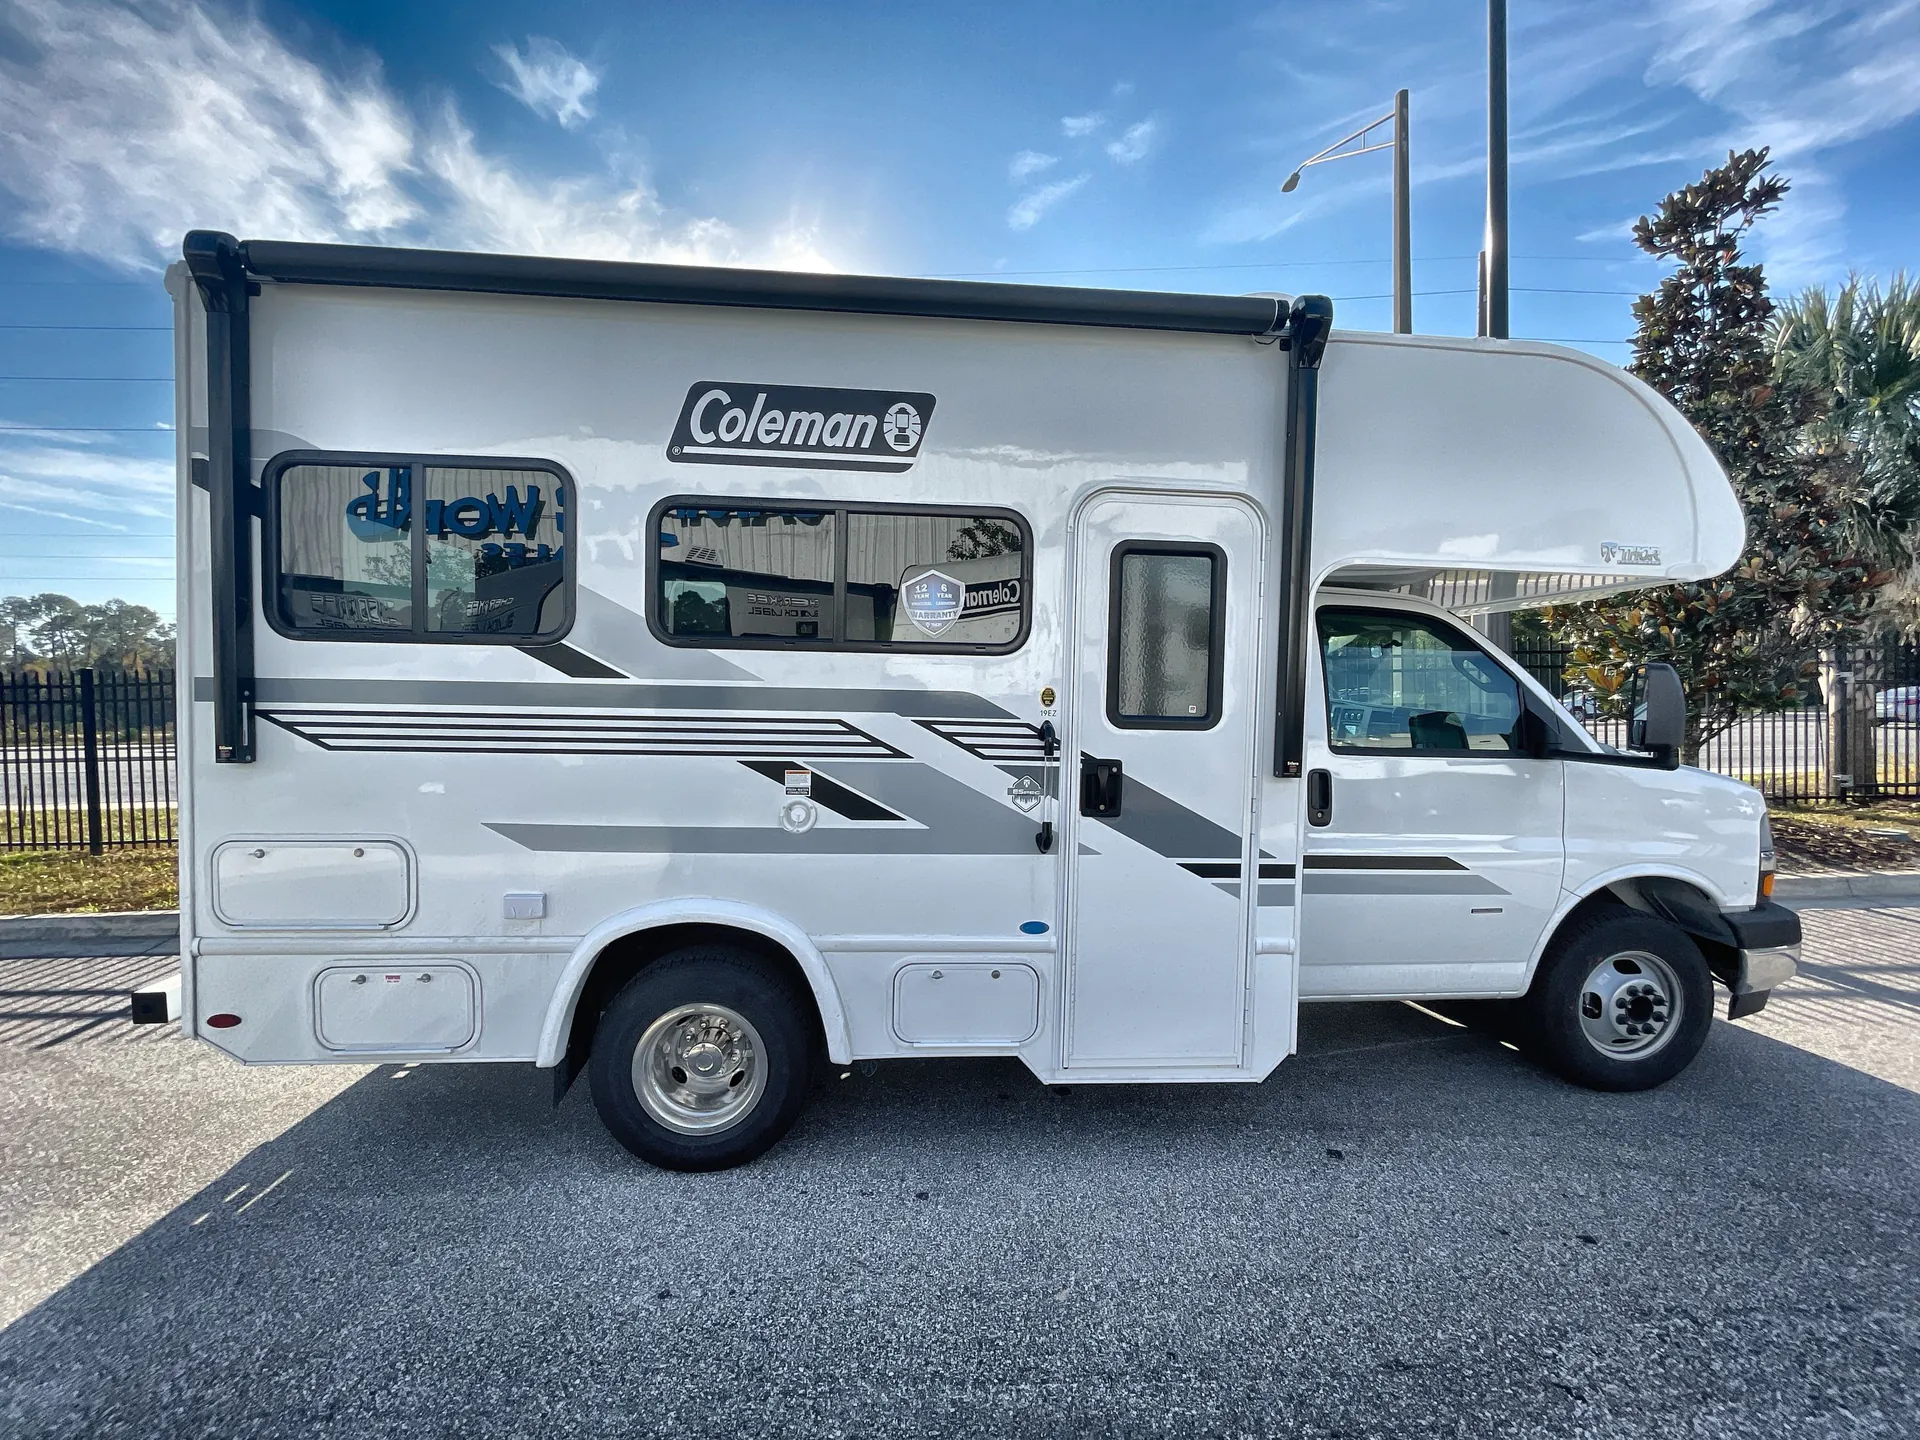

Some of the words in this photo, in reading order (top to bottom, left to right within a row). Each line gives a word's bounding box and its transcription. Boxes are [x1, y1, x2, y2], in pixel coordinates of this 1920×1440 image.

[689, 388, 878, 449] Coleman
[1617, 546, 1661, 561] THOR
[915, 583, 928, 593] 12
[940, 583, 948, 593] 6
[910, 609, 958, 619] WARRANTY
[1040, 709, 1057, 717] 19EZ
